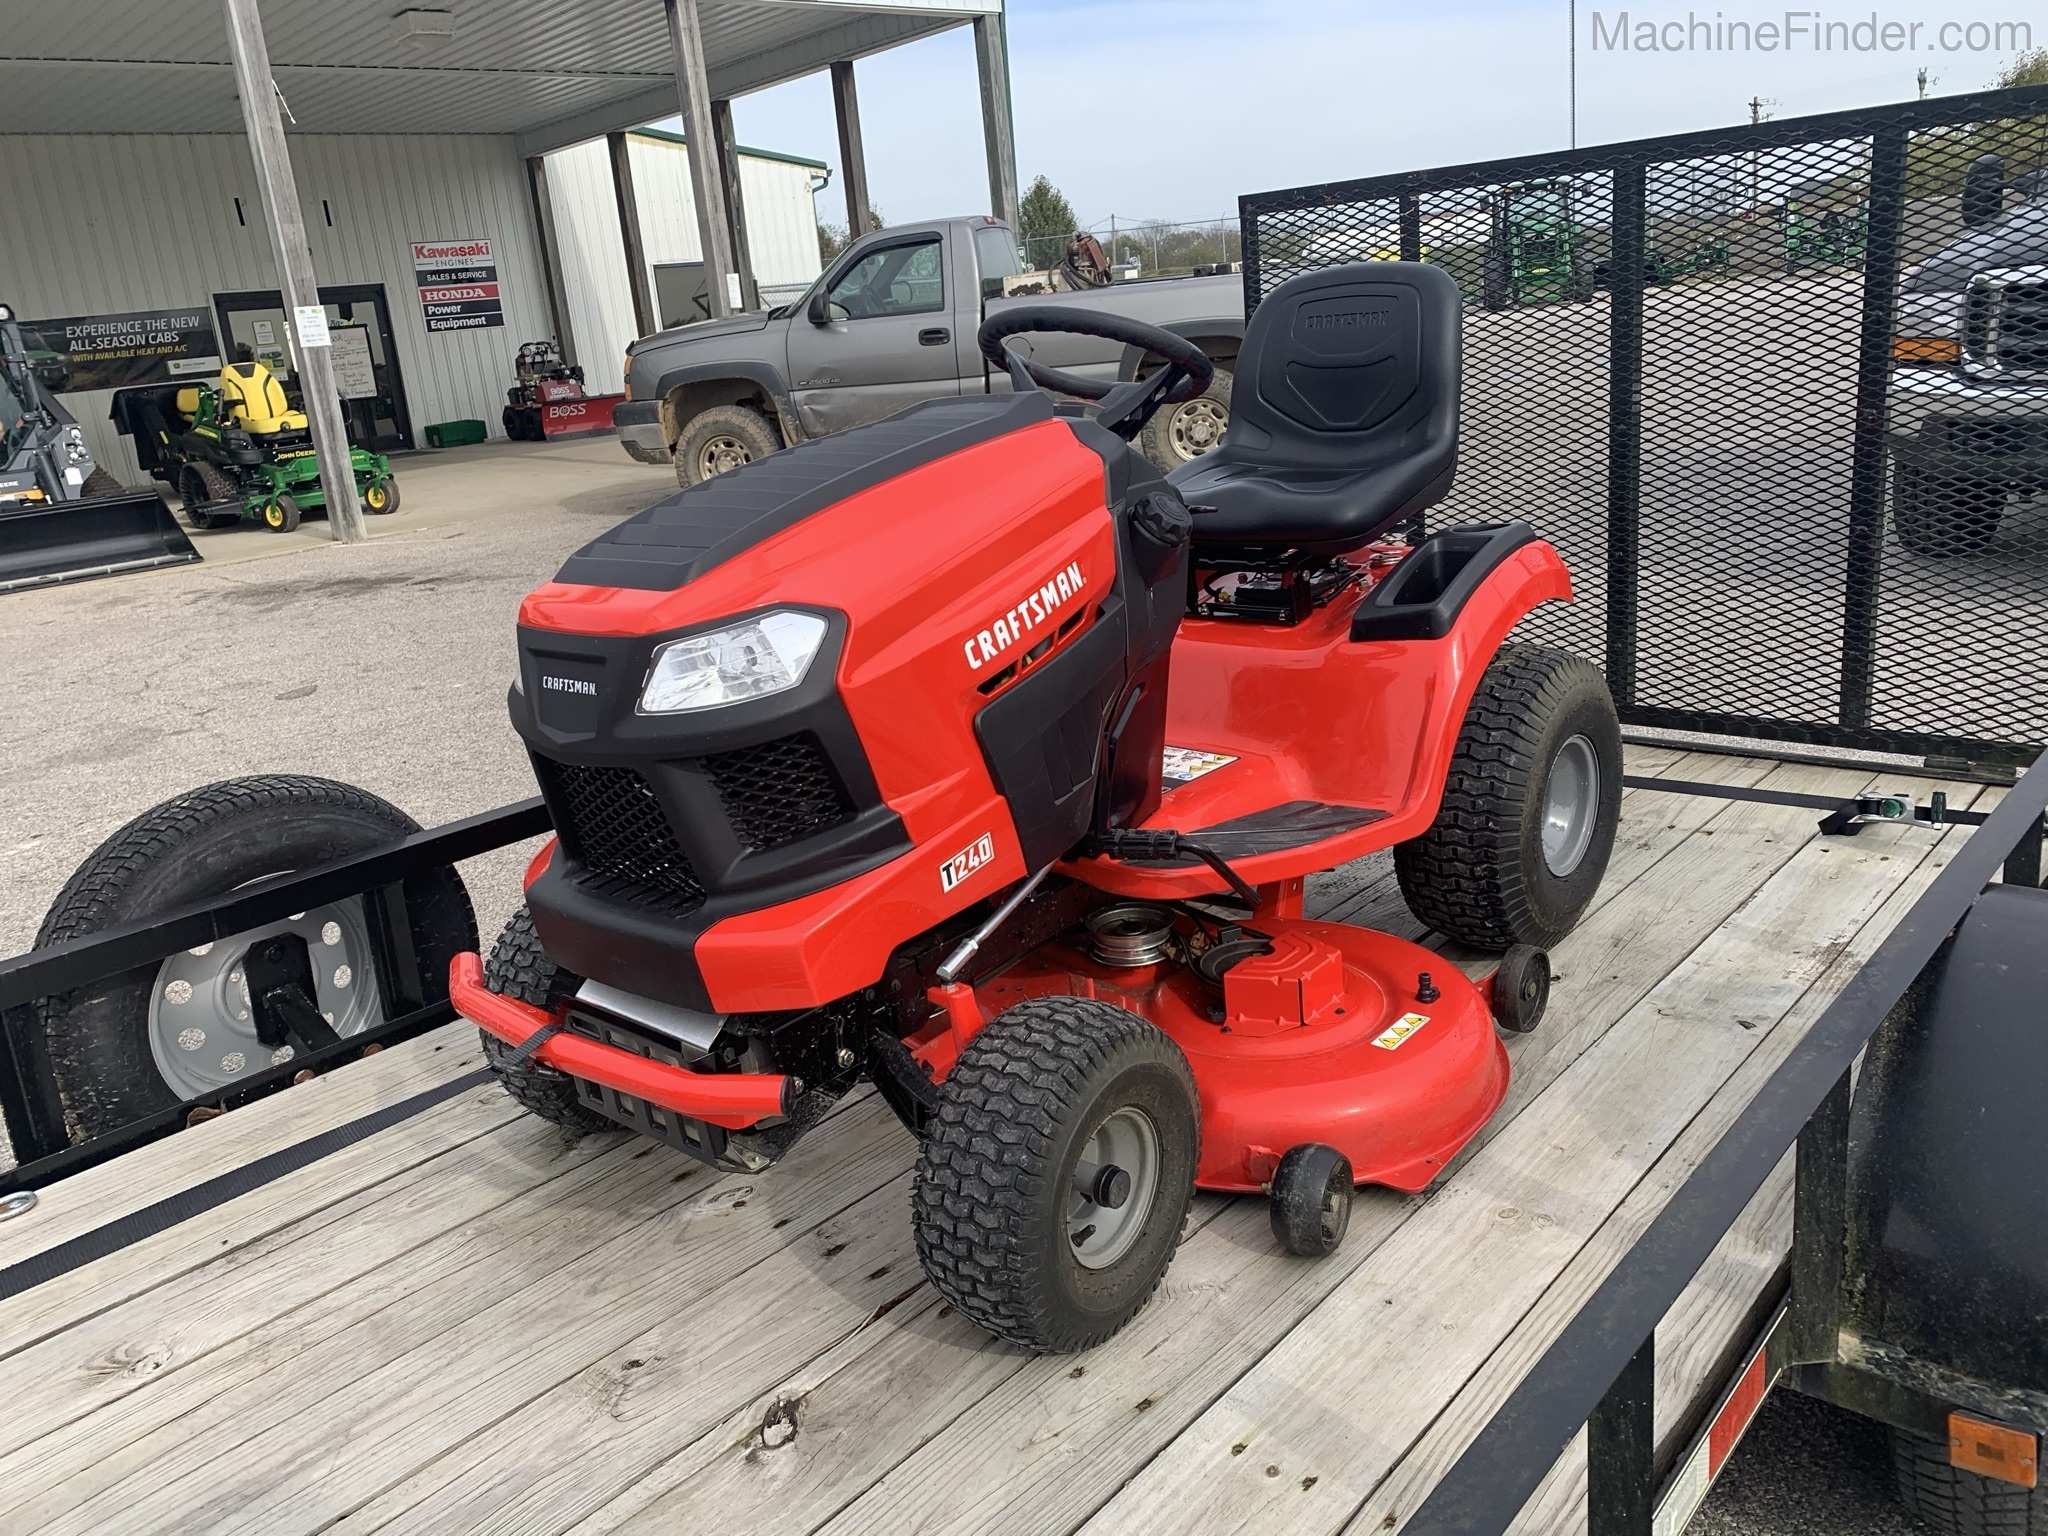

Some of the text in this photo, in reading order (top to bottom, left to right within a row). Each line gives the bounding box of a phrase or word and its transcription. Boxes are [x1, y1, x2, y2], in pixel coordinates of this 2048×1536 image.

[414, 242, 489, 259] Kawasaki
[436, 258, 475, 267] ENGINES
[426, 273, 450, 281] SALES
[457, 271, 487, 279] SERVICE
[425, 288, 486, 301] HONDA
[428, 305, 461, 315] Power
[66, 316, 200, 338] EXPERIENCE THE NEW
[430, 316, 486, 330] Equipment
[1305, 310, 1389, 328] CRAFTSMAN
[69, 331, 179, 352] ALL-SEASON CABS
[72, 344, 187, 362] WITH AVAILABLE HEAT AND A/C
[550, 386, 570, 395] BOSS
[550, 403, 586, 418] BOSS
[277, 452, 295, 460] JOHN
[964, 561, 1084, 670] CRAFTSMAN
[543, 676, 597, 695] CRAFTSMAN
[941, 837, 993, 887] T240
